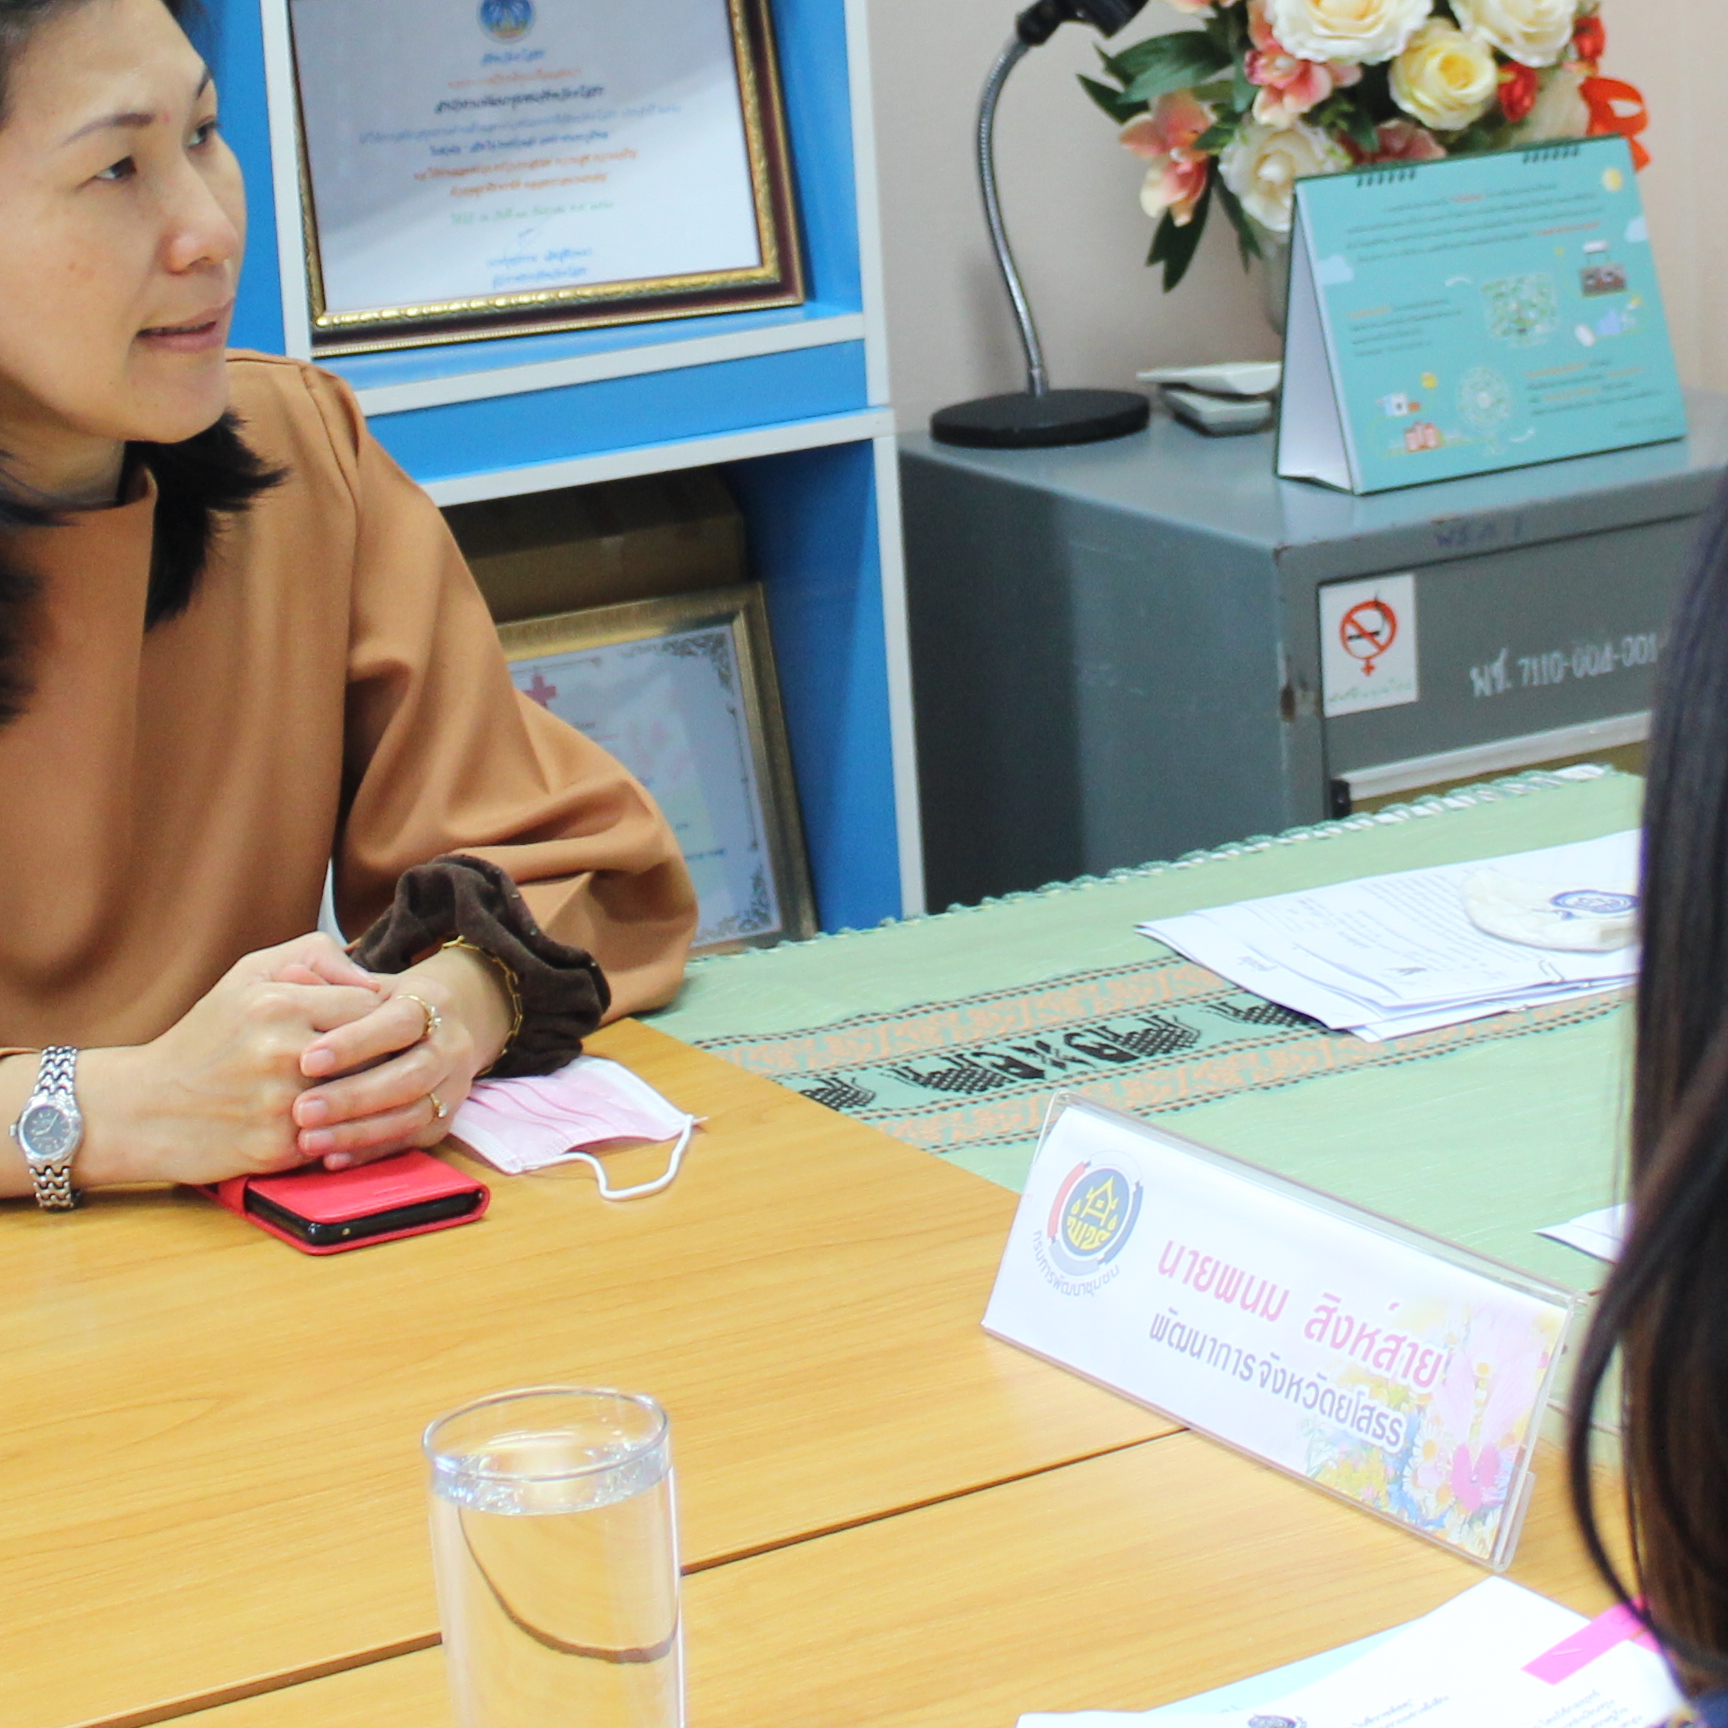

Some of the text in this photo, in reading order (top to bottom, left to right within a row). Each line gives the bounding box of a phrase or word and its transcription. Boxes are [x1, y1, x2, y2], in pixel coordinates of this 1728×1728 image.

[1157, 1239, 1444, 1389] นายพนม สิงห์สาย
